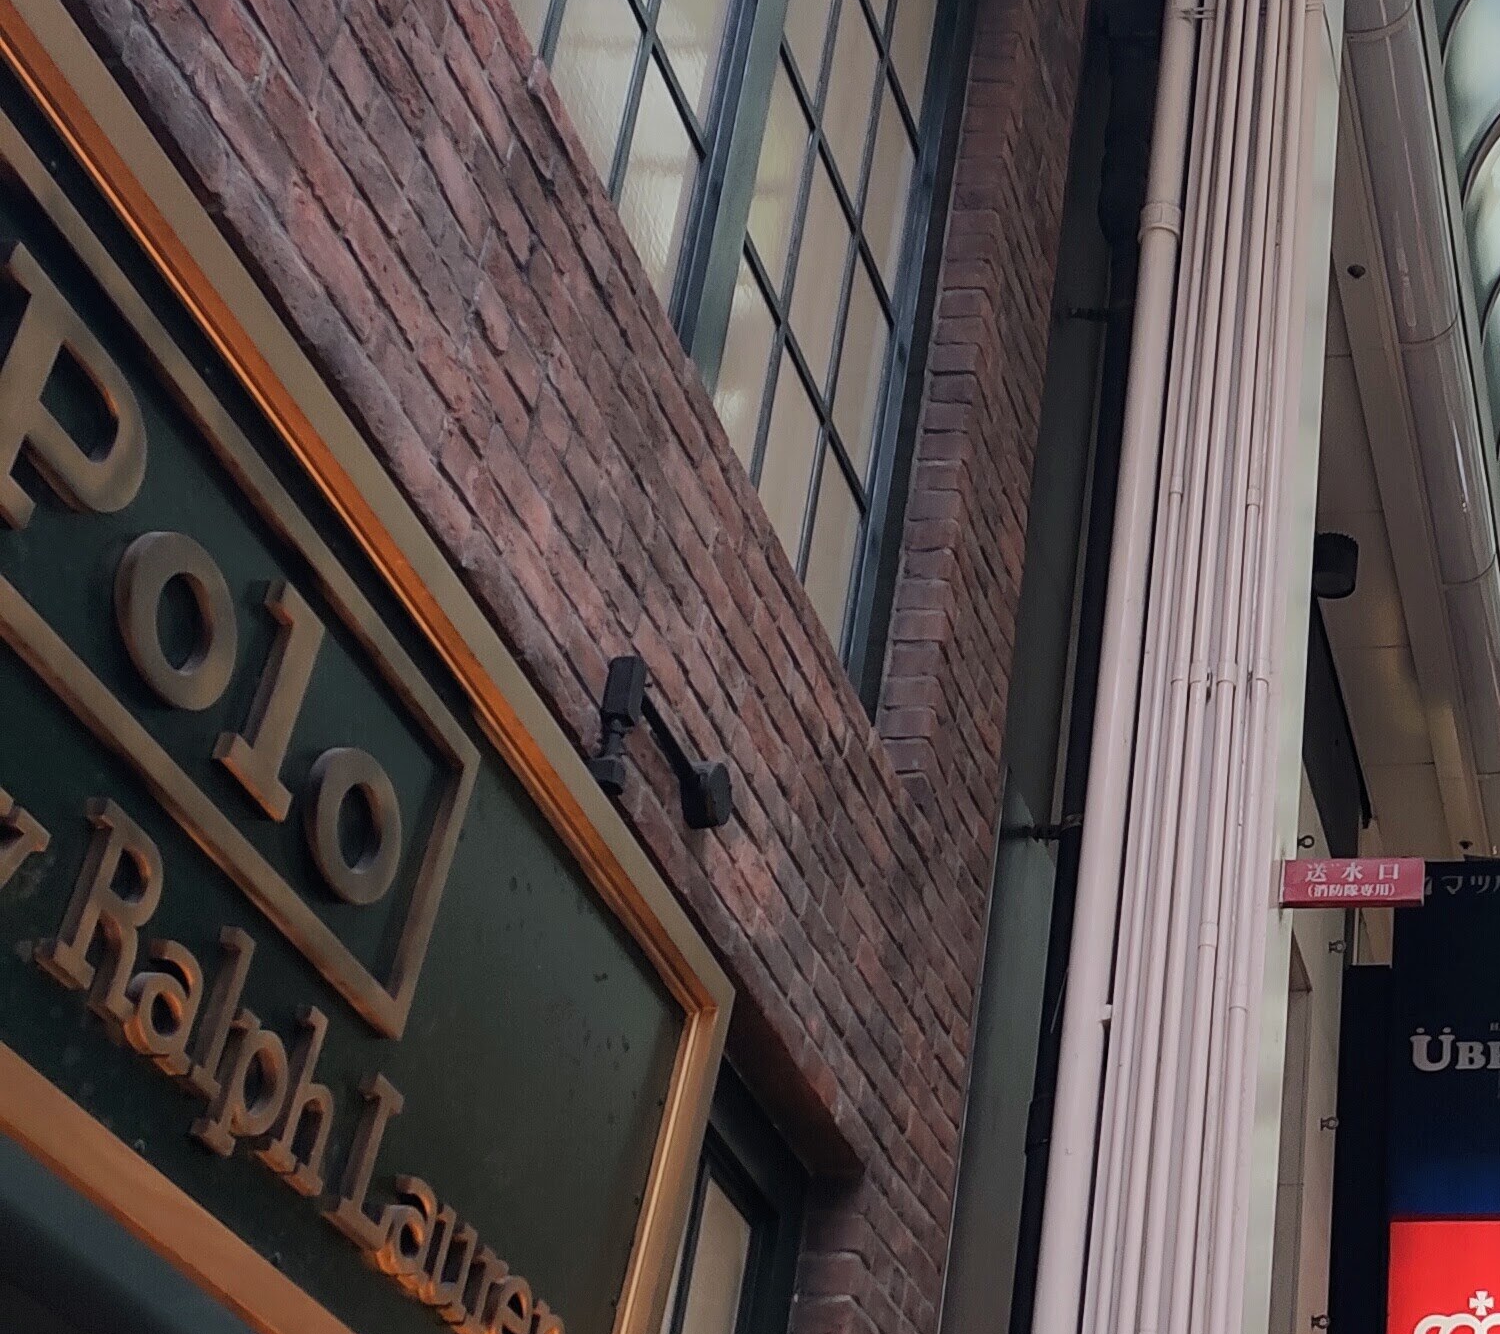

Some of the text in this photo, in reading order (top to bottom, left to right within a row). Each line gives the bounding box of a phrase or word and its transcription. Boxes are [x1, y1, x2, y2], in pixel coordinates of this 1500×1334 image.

[0, 241, 400, 905] Polo
[36, 797, 333, 1199] Ralph
[1305, 863, 1400, 883] 送水口
